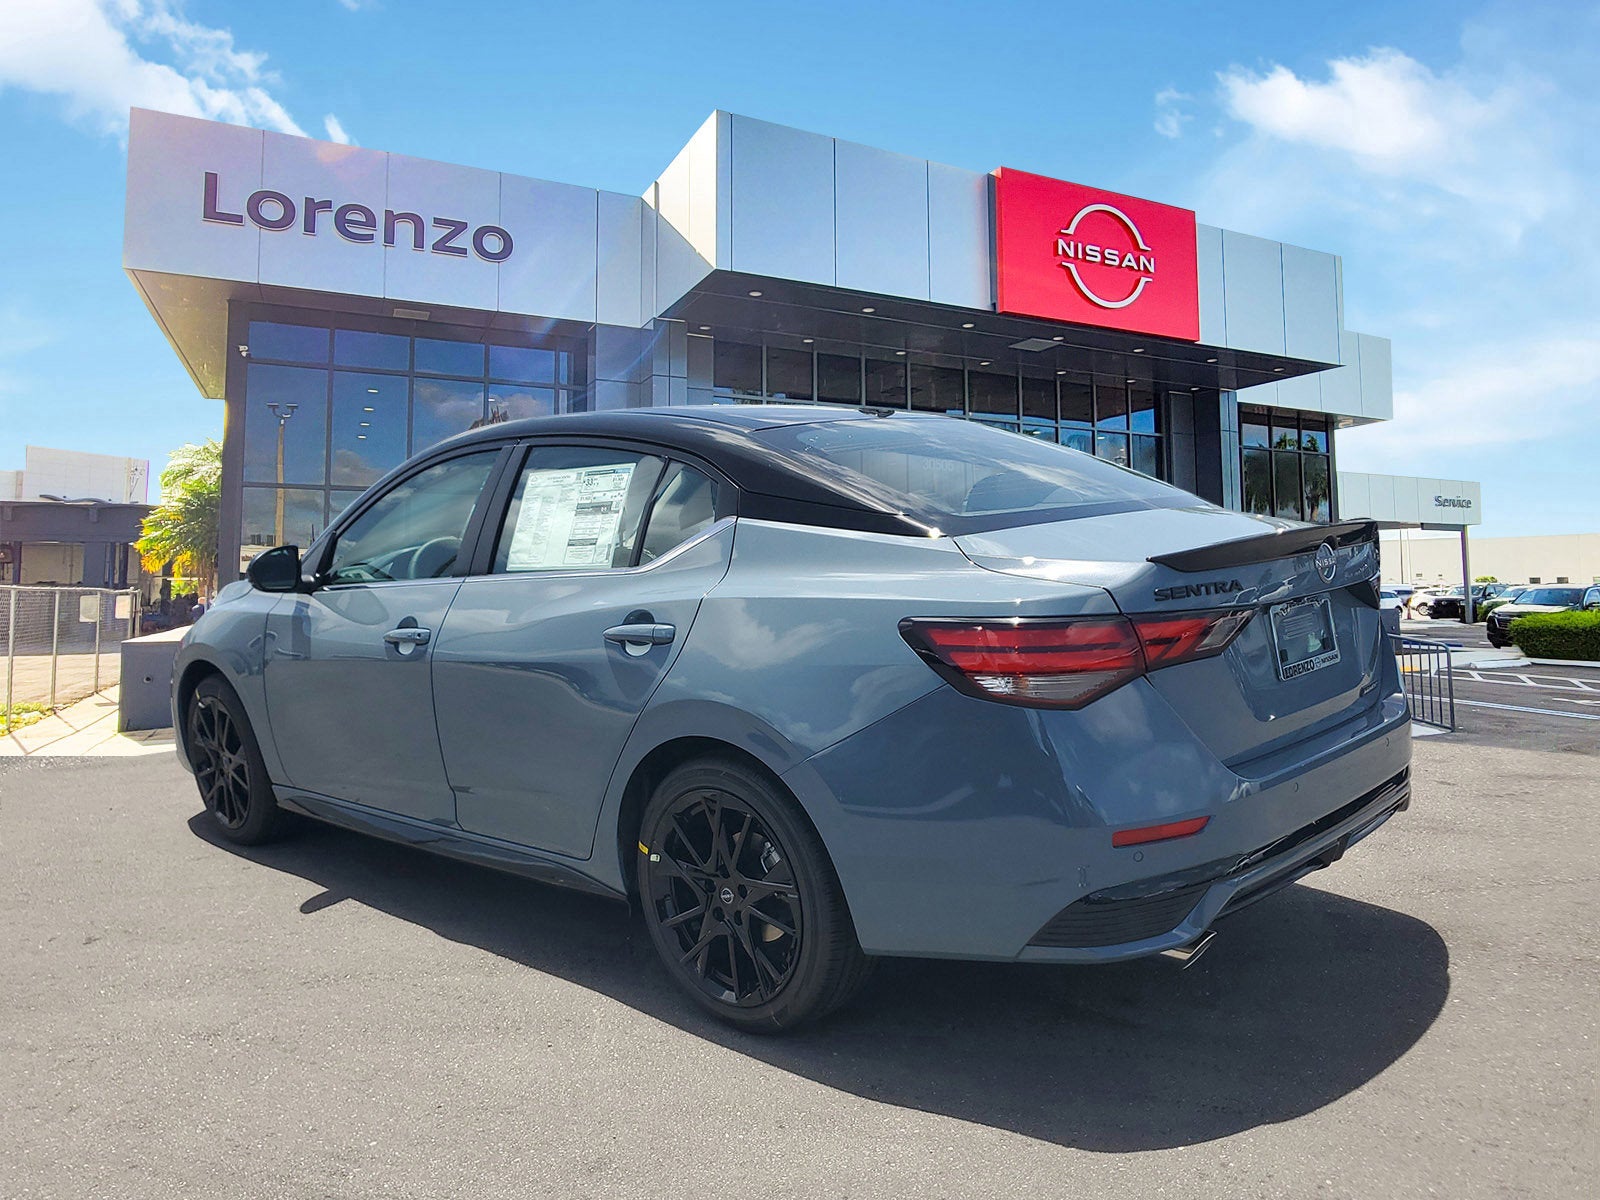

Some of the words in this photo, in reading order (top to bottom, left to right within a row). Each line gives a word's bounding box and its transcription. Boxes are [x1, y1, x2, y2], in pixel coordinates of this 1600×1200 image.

[203, 171, 514, 262] Lorenzo
[1057, 238, 1155, 273] NISSAN
[1434, 495, 1472, 508] Service
[1154, 579, 1243, 601] SENTRA
[1283, 659, 1315, 679] LORENZO
[1320, 653, 1339, 664] NISSAN
